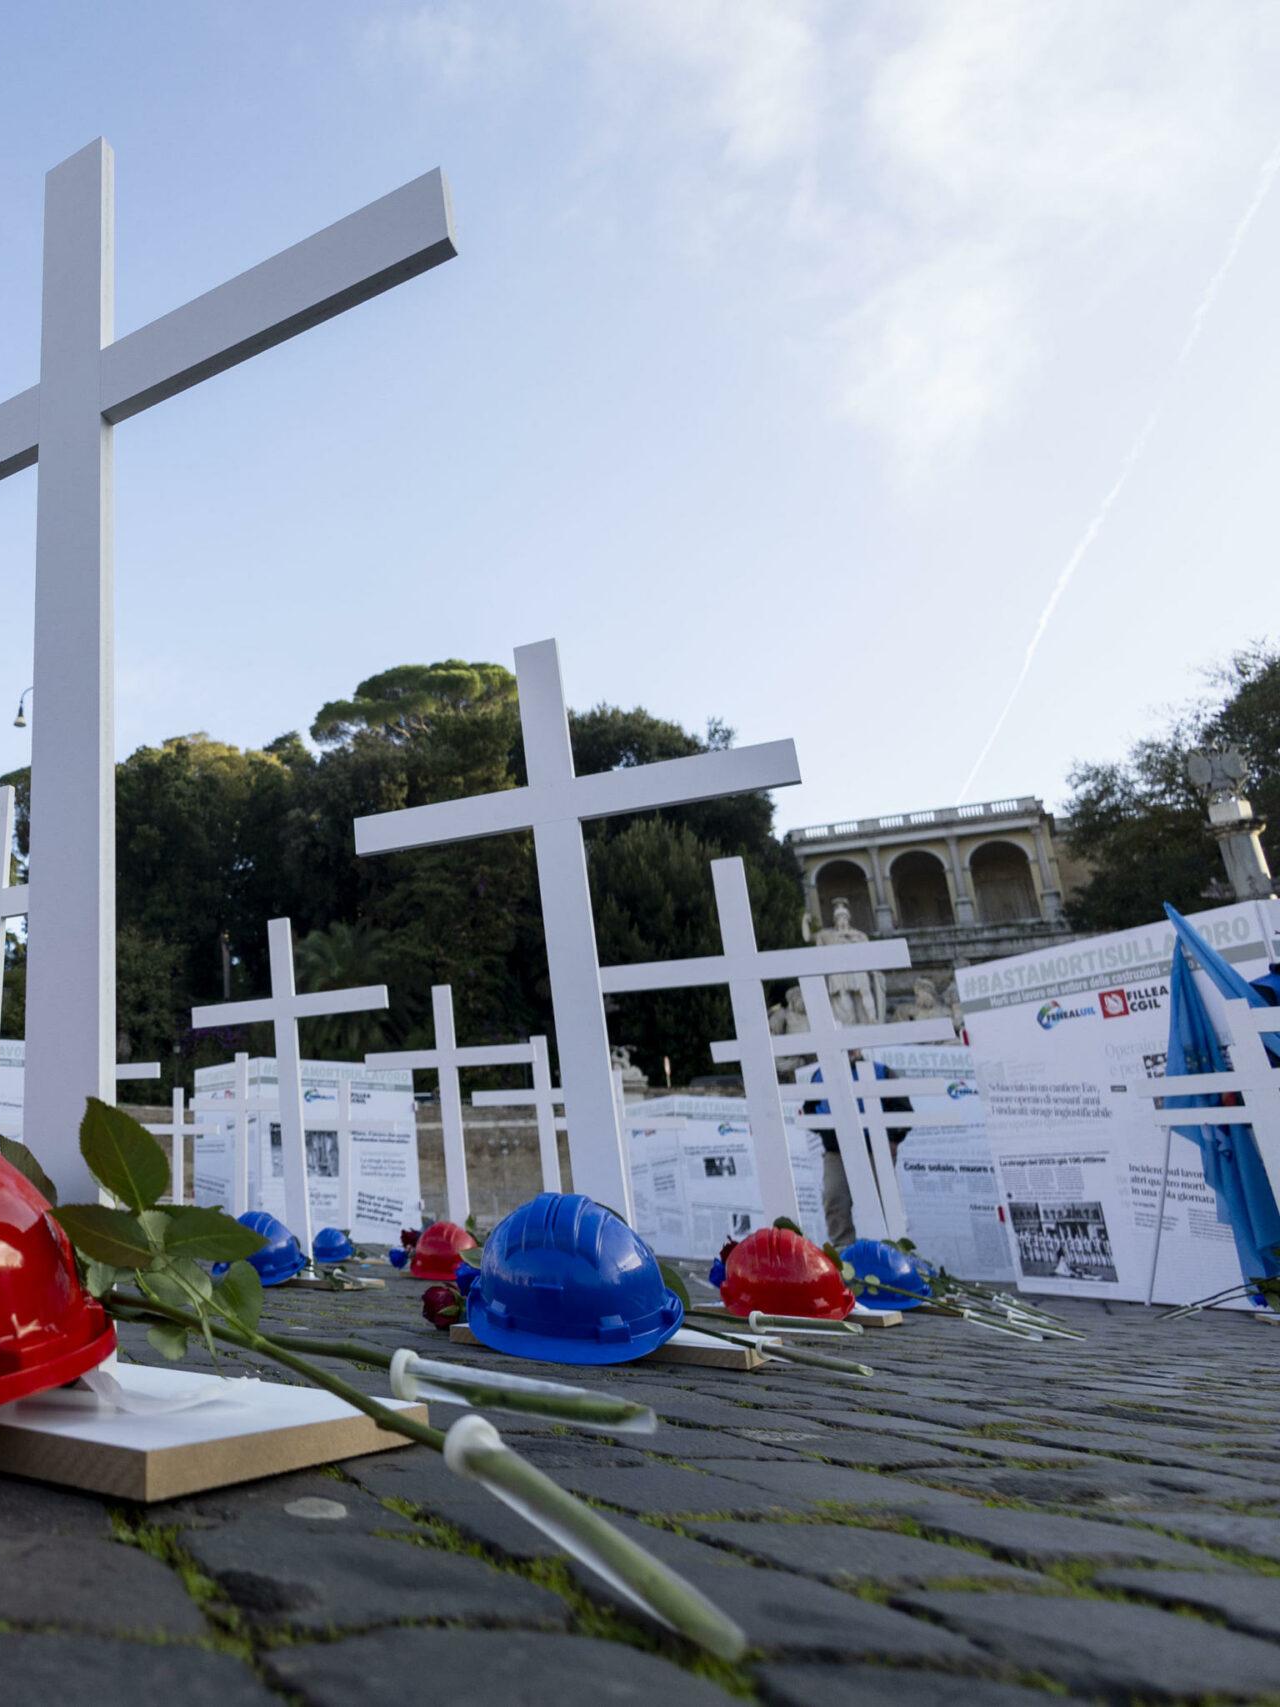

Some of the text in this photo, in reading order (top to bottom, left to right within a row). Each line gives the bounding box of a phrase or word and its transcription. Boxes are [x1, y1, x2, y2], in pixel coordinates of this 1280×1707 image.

[963, 916, 1249, 997] #BASTAMORTISULLAORO
[1111, 964, 1160, 984] costruzioni
[1126, 985, 1169, 1001] FILLEA
[1130, 999, 1161, 1012] CGIL
[1129, 1163, 1162, 1175] Incident
[1181, 1168, 1204, 1178] lavor
[1148, 1178, 1180, 1188] qutro
[1177, 1192, 1215, 1204] giornata
